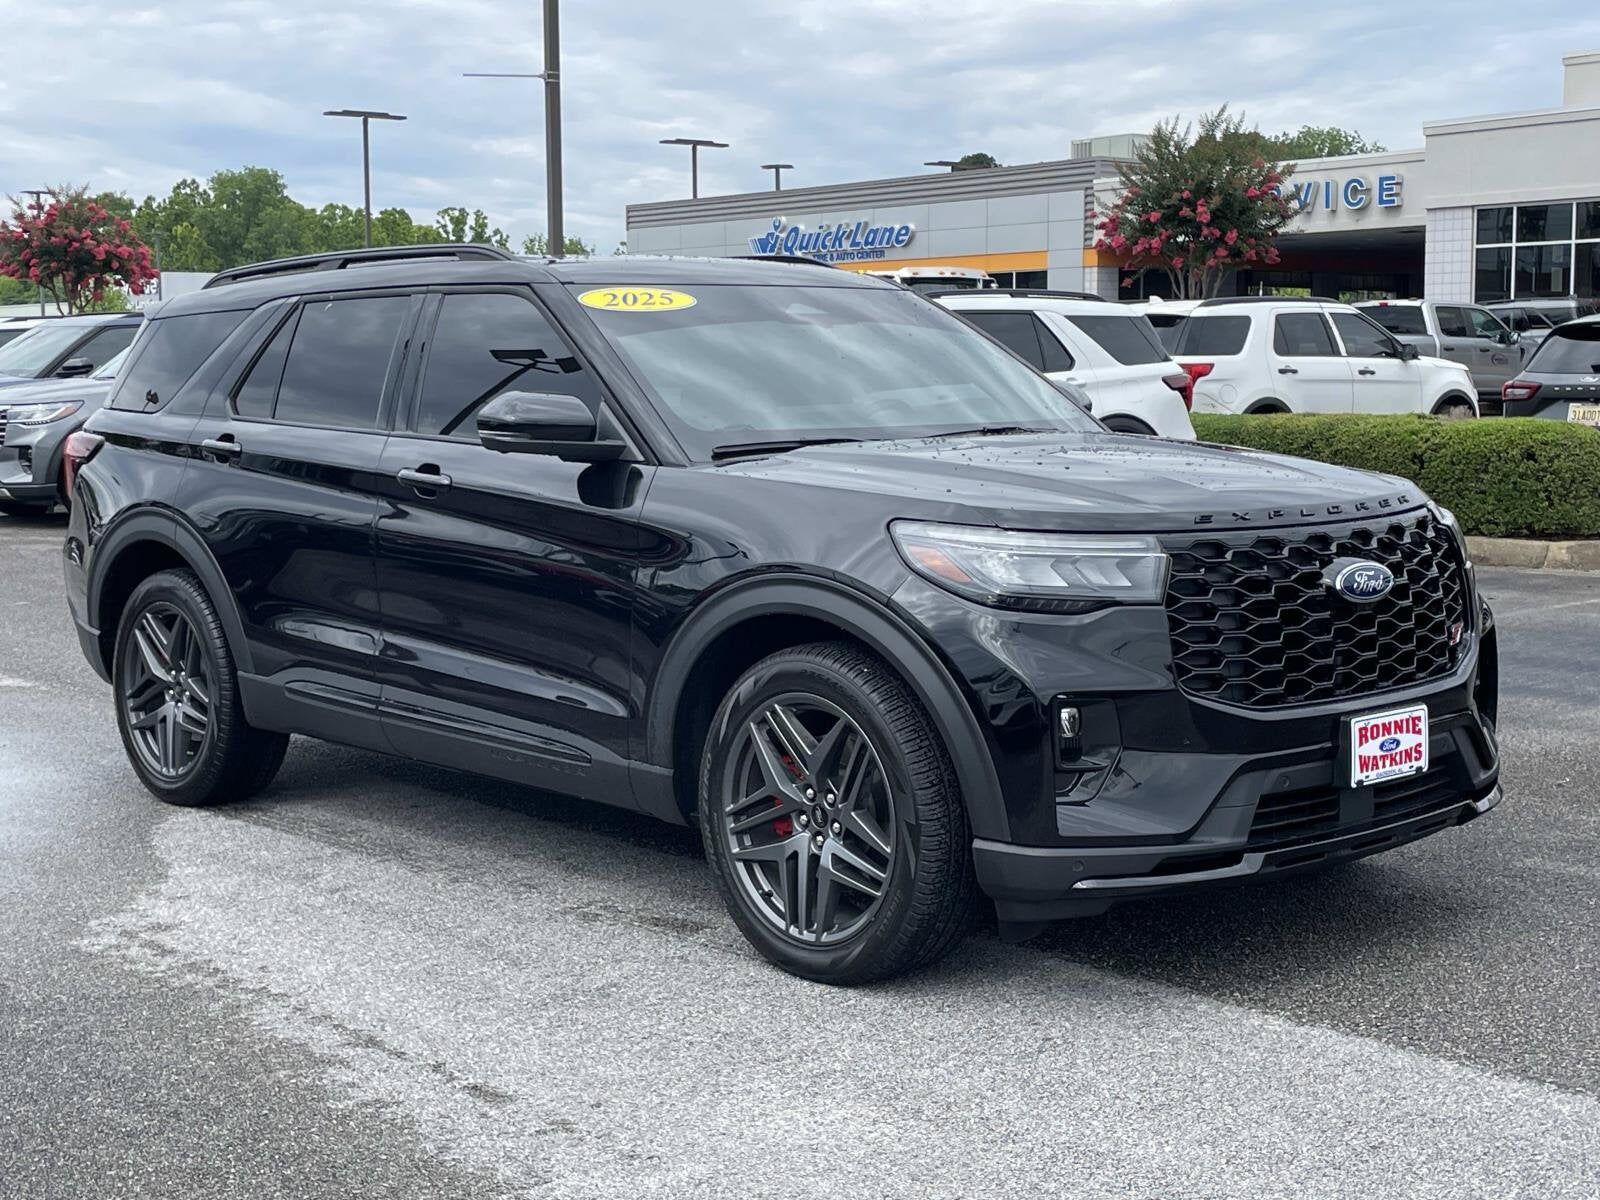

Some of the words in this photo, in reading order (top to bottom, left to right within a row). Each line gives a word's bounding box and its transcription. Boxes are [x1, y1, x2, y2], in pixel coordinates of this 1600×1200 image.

[1270, 174, 1402, 211] VICE
[782, 222, 849, 256] Quick
[849, 218, 911, 251] Lane
[836, 251, 856, 262] AUTO
[856, 249, 886, 261] CENTER
[602, 291, 674, 307] 2025
[1194, 494, 1410, 525] EXPLORER
[1352, 570, 1386, 594] Ford
[1358, 715, 1423, 748] RONNIE
[1358, 742, 1424, 774] WATKINS
